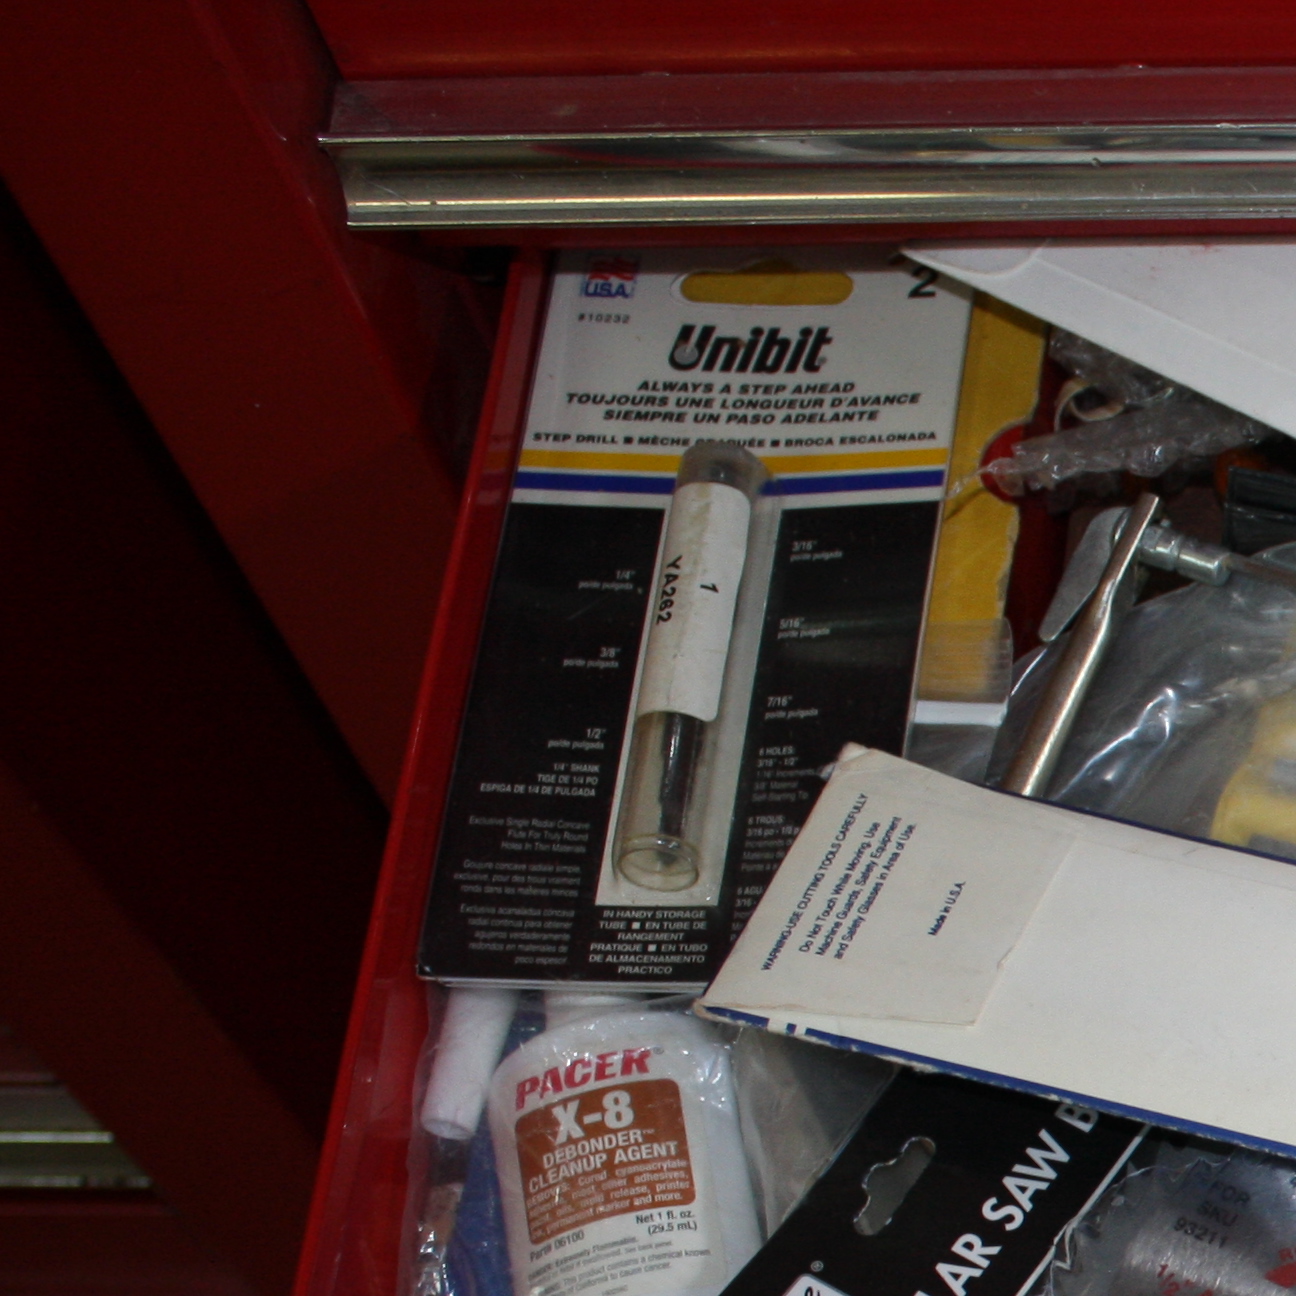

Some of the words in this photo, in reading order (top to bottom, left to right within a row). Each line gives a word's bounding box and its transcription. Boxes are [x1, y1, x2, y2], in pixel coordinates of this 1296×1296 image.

[907, 268, 936, 298] 2
[577, 313, 629, 323] #10232
[667, 321, 832, 375] Unibit
[638, 379, 713, 393] ALWAYS
[719, 383, 732, 393] A
[738, 382, 785, 395] STEP
[793, 380, 854, 395] AHEAD
[566, 392, 667, 407] TOUJOURS
[675, 394, 713, 408] UNE
[720, 393, 823, 411] LONGUEUR
[830, 389, 920, 410] D'AVANCE
[602, 408, 685, 422] SIEMPRE
[693, 410, 719, 423] UN
[726, 410, 774, 424] PASO
[781, 406, 878, 426] ADELANTE
[532, 433, 566, 446] STEP
[575, 433, 617, 444] DRILL
[784, 435, 833, 448] BROCA
[839, 428, 935, 447] ESCALONADA
[655, 554, 684, 627] YA262
[796, 870, 825, 911] CUTTING
[817, 840, 841, 872] TOOLS
[834, 792, 869, 843] CAREFULLY
[798, 939, 812, 954] Do
[806, 922, 822, 940] Not
[816, 895, 838, 924] Touch
[832, 871, 852, 896] While
[863, 820, 881, 840] Use
[814, 918, 843, 957] Machine
[854, 858, 878, 888] Safety
[870, 815, 903, 861] Equipment
[599, 920, 626, 929] TUBE
[616, 909, 652, 919] HANDY
[655, 909, 706, 920] STORAGE
[928, 912, 947, 937] Made
[617, 931, 684, 941] RANGEMENT
[662, 921, 690, 930] TUBE
[693, 921, 706, 929] DE
[832, 941, 848, 960] and
[841, 913, 866, 944] Safety
[590, 942, 643, 953] PRATIQUE
[679, 943, 707, 952] TUBO
[589, 954, 602, 962] DE
[605, 952, 705, 965] ALMACENAMIENTO
[516, 1048, 654, 1110] PACER
[549, 1092, 638, 1146] X-8
[541, 1131, 644, 1170] DEBONDER
[529, 1155, 609, 1192] CLEANUP
[613, 1140, 679, 1166] AGENT
[981, 1129, 1074, 1233] SAW
[635, 1213, 654, 1224] Net
[657, 1212, 663, 1220] 1
[679, 1208, 694, 1218] oz.
[647, 1223, 673, 1235] (29.5
[676, 1220, 697, 1232] mL)
